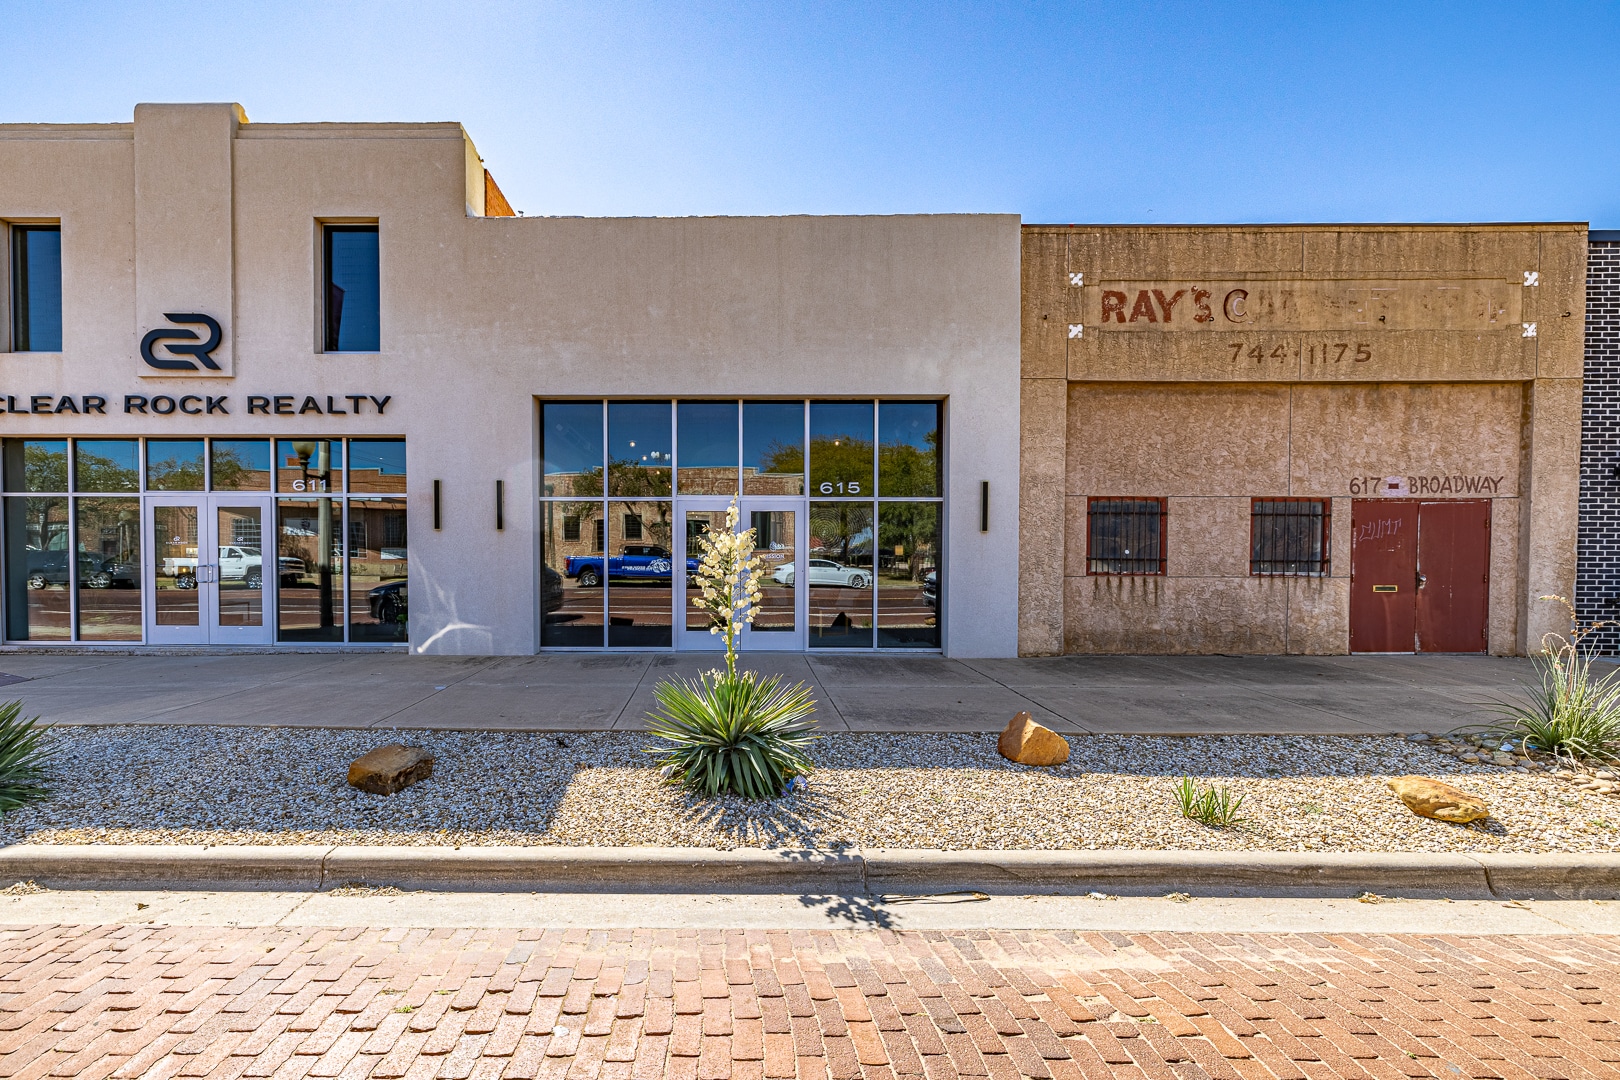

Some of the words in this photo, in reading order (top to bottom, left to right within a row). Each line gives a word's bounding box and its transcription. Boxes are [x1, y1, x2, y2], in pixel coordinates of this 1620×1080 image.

[1100, 285, 1212, 324] RAY'S
[0, 394, 107, 416] LEAR
[124, 394, 229, 416] ROCK
[247, 394, 392, 416] REALTY
[292, 479, 327, 492] 611
[819, 481, 861, 495] 615
[1350, 476, 1382, 496] 617
[1407, 475, 1504, 495] BROADWAY
